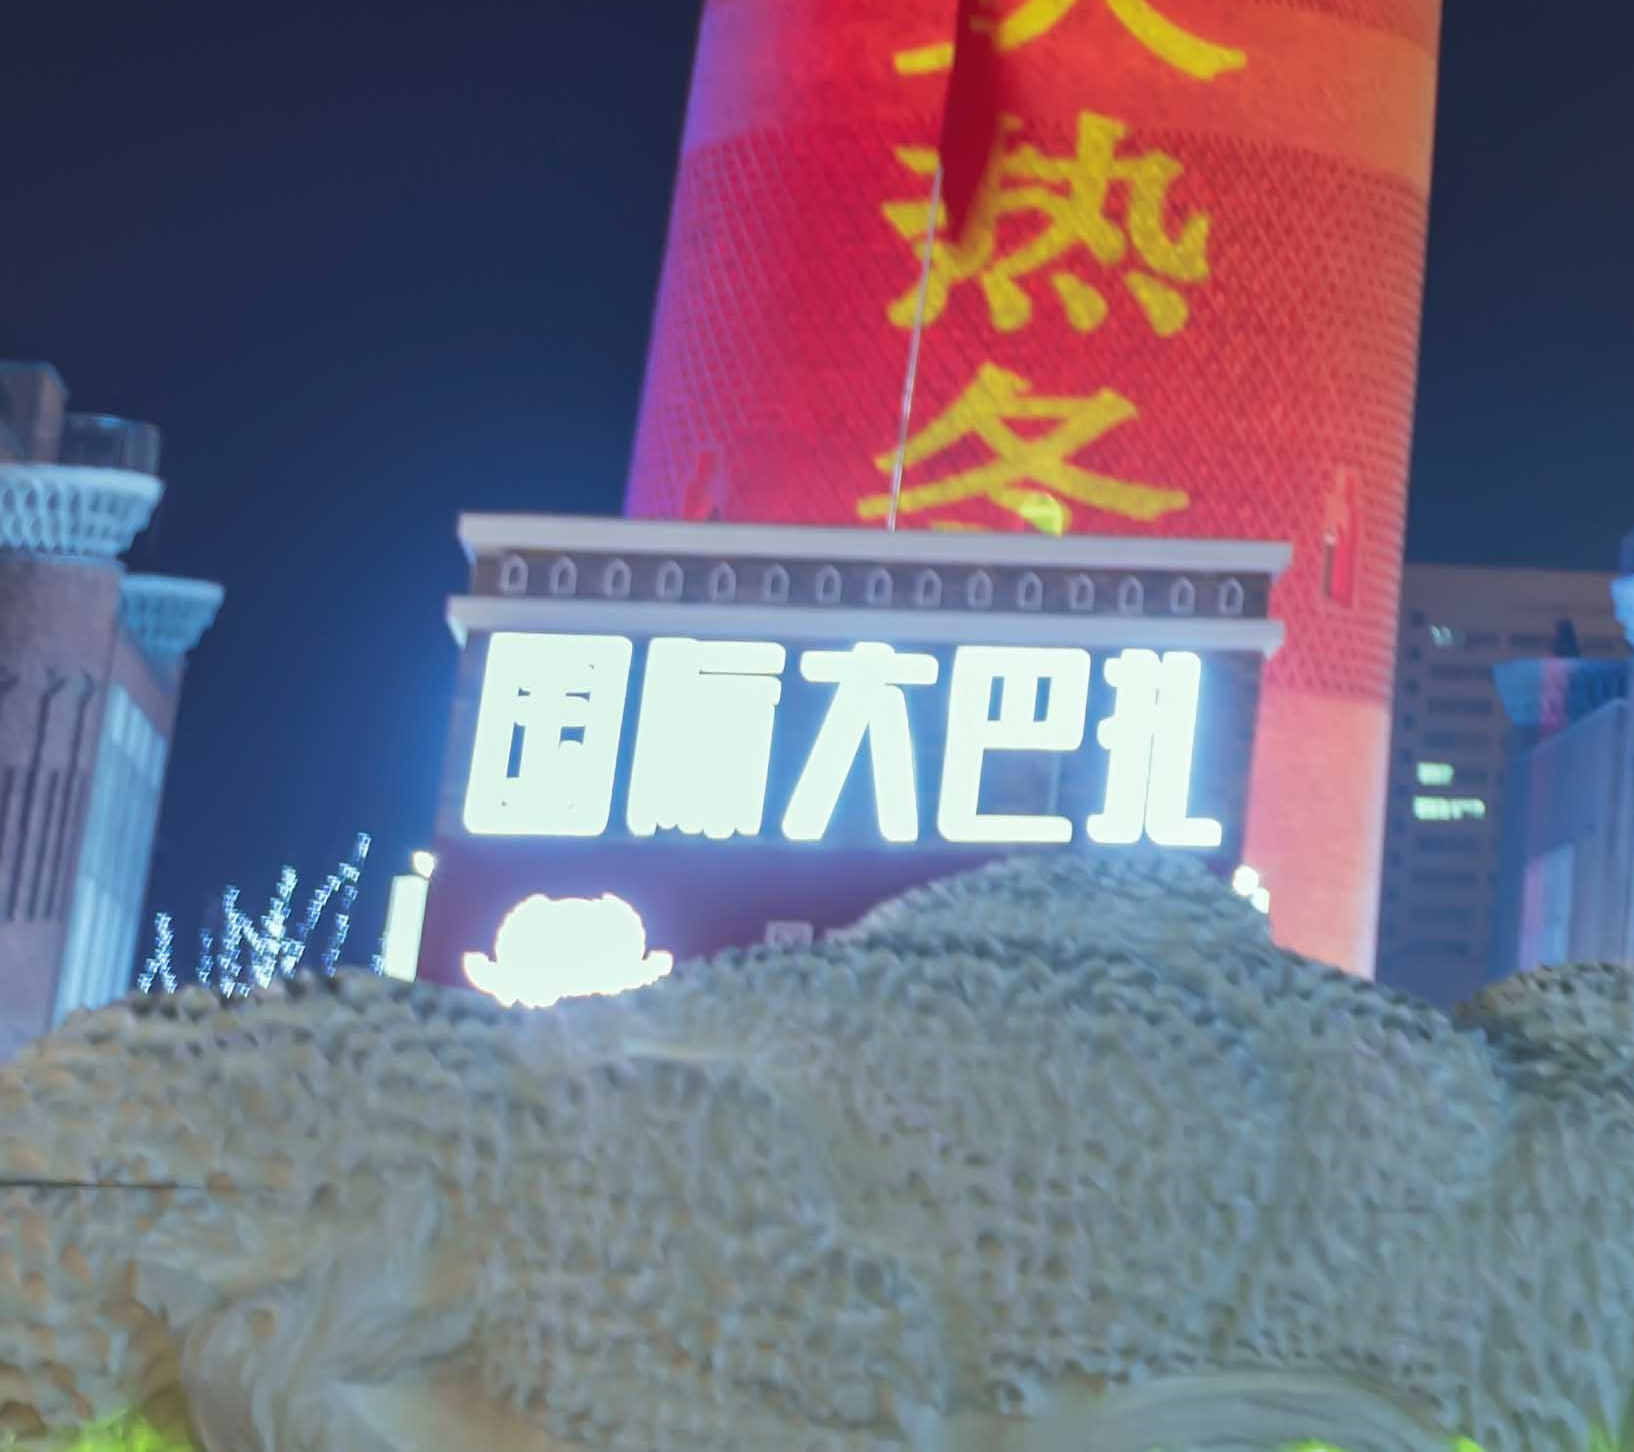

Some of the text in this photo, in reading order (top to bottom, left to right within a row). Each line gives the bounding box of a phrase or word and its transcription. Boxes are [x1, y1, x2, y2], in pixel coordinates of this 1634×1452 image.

[464, 632, 1222, 846] 国际大巴扎
